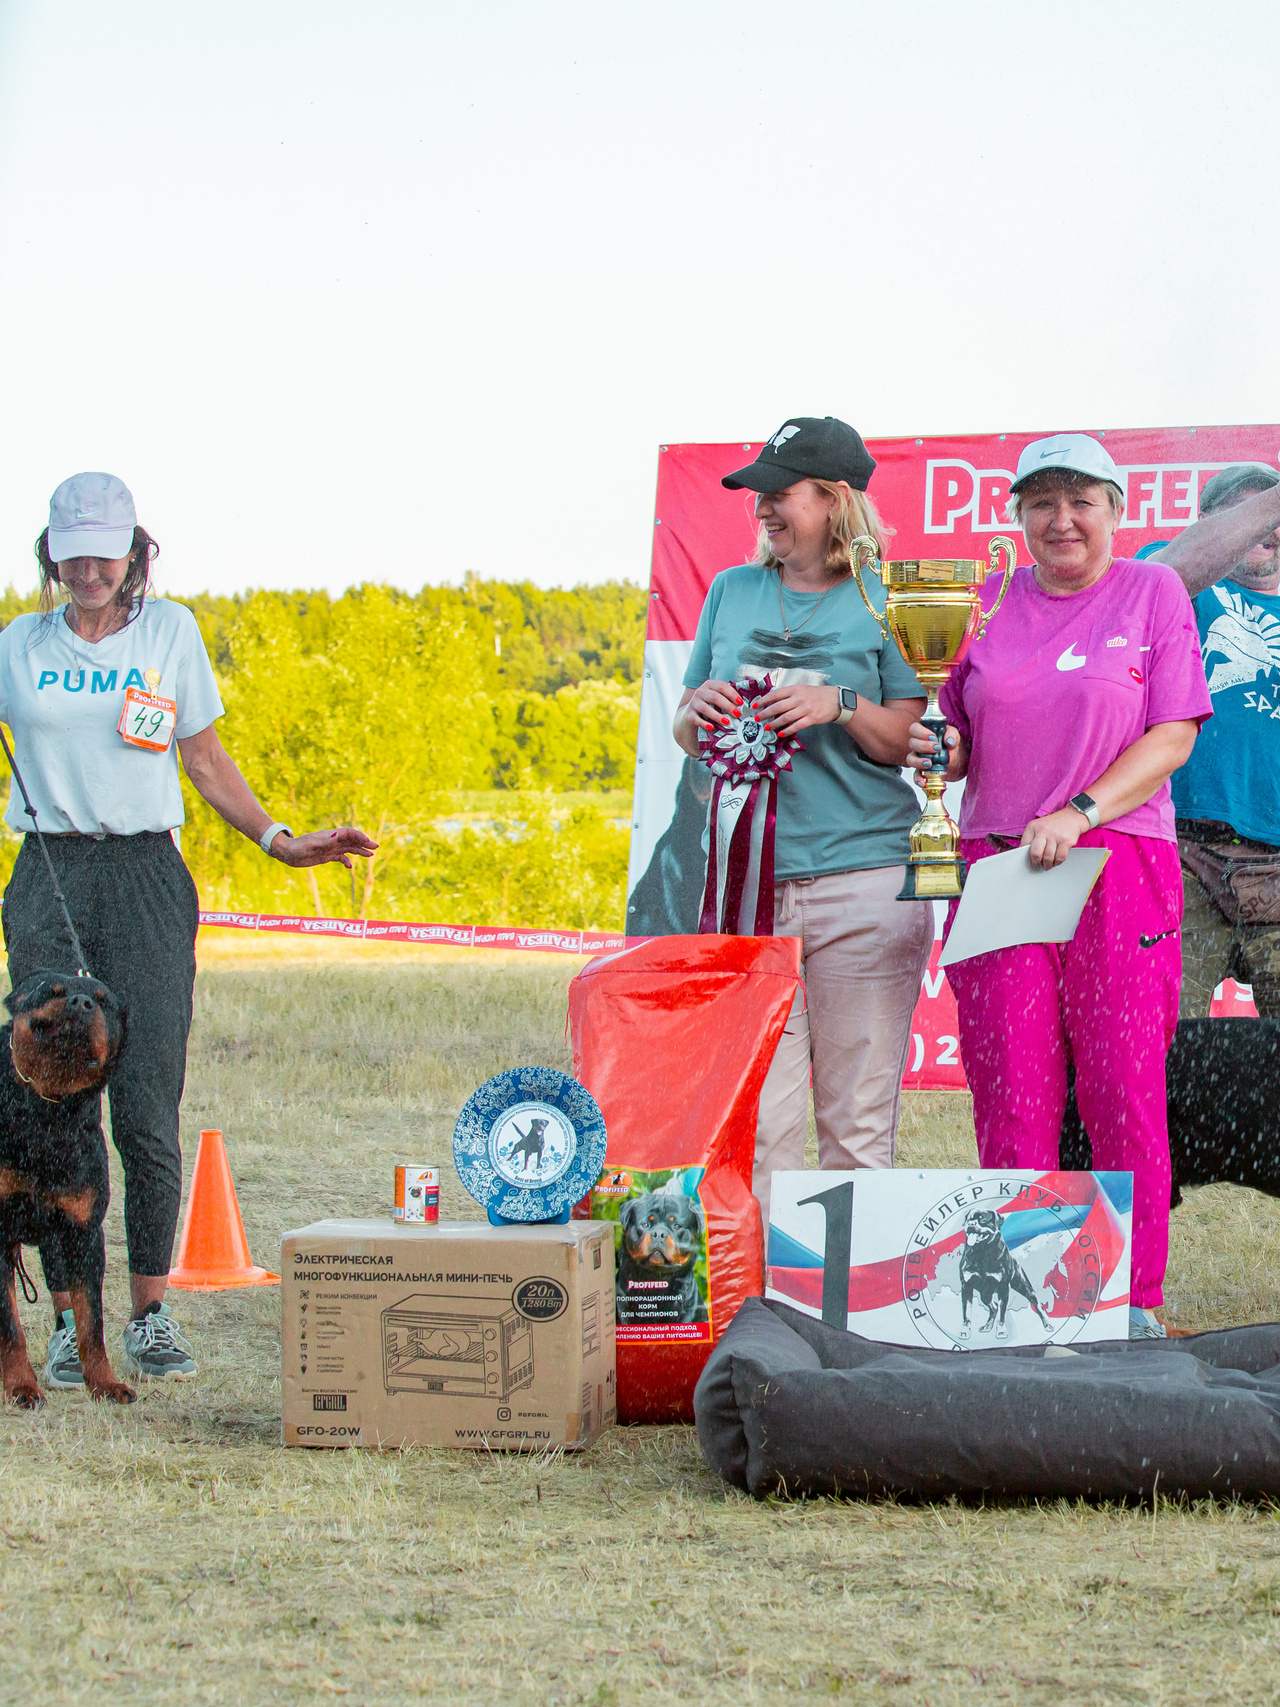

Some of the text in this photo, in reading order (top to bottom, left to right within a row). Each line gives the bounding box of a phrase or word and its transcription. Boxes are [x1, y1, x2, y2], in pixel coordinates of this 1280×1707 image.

[37, 668, 146, 694] PUMA
[134, 706, 164, 738] 49
[303, 919, 364, 934] ТРАПЕЗА
[411, 927, 470, 942] ТРАПЕЗА
[518, 934, 579, 949] ТРАПЕЗА
[594, 1185, 629, 1194] PROFIFEED
[797, 1181, 854, 1331] 1
[905, 1182, 1098, 1321] РОТВЕЙЛЕР КЛУБ РОССИИ
[294, 1253, 394, 1266] ЭЛЕКТРИЧЕСКАЯ
[294, 1271, 513, 1284] МНОГОФУНКЦИОНАЛЬНАЯ МИНИ-ПЕЧЬ
[628, 1280, 669, 1289] PROFIFEED
[522, 1299, 546, 1308] 1280
[616, 1293, 683, 1302] ПОЛНОРАЦИОННЫЙ
[635, 1310, 679, 1318] ЧЕМПИОНОВ
[670, 1324, 698, 1332] ПОДХОД
[296, 1426, 361, 1436] GFO-20W
[455, 1429, 550, 1439] WWW.GFGRIL.RU
